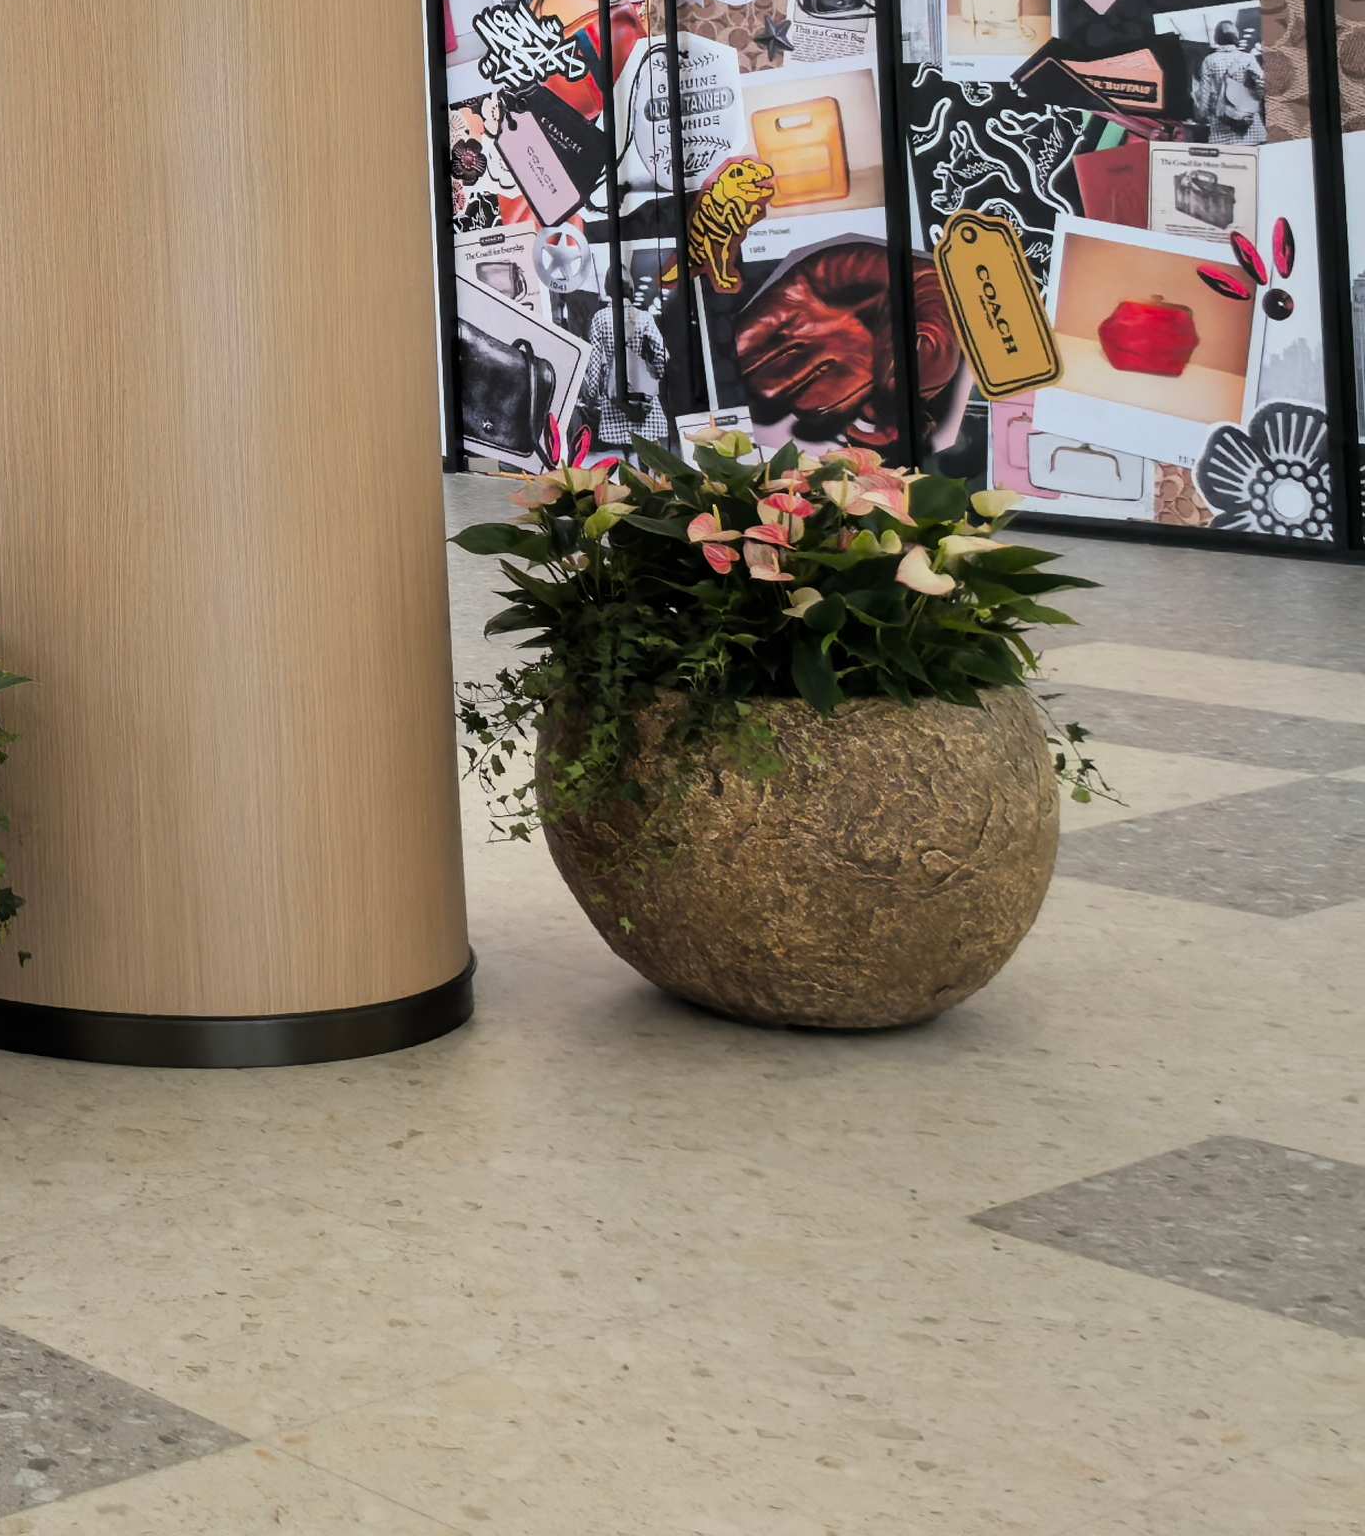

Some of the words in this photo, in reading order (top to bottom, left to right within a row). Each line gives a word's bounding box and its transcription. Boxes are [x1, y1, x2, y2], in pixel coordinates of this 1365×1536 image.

[793, 24, 810, 34] This
[824, 28, 848, 39] Coach
[849, 32, 865, 43] Bag
[685, 89, 728, 111] TANNED
[541, 116, 583, 154] COACH
[526, 145, 558, 196] COACH
[975, 264, 1018, 354] COACH
